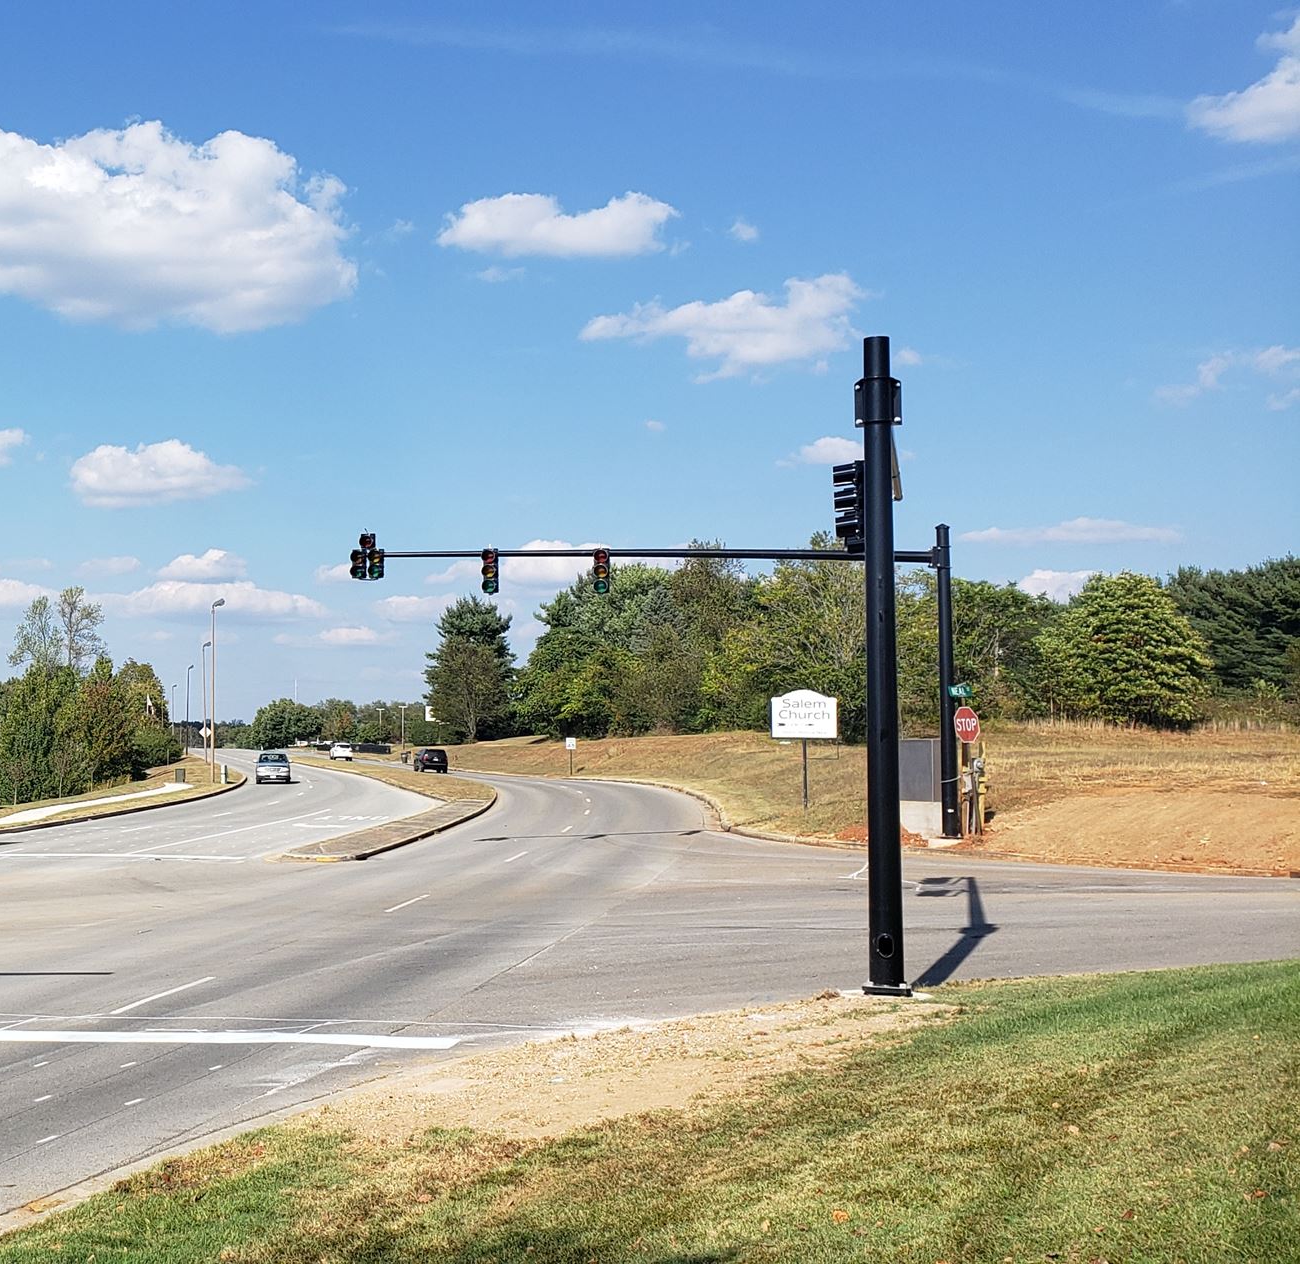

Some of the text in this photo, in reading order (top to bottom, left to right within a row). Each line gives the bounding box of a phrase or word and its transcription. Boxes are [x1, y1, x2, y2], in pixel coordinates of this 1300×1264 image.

[782, 698, 827, 709] Salem
[778, 709, 831, 720] Church
[956, 718, 977, 732] STOP
